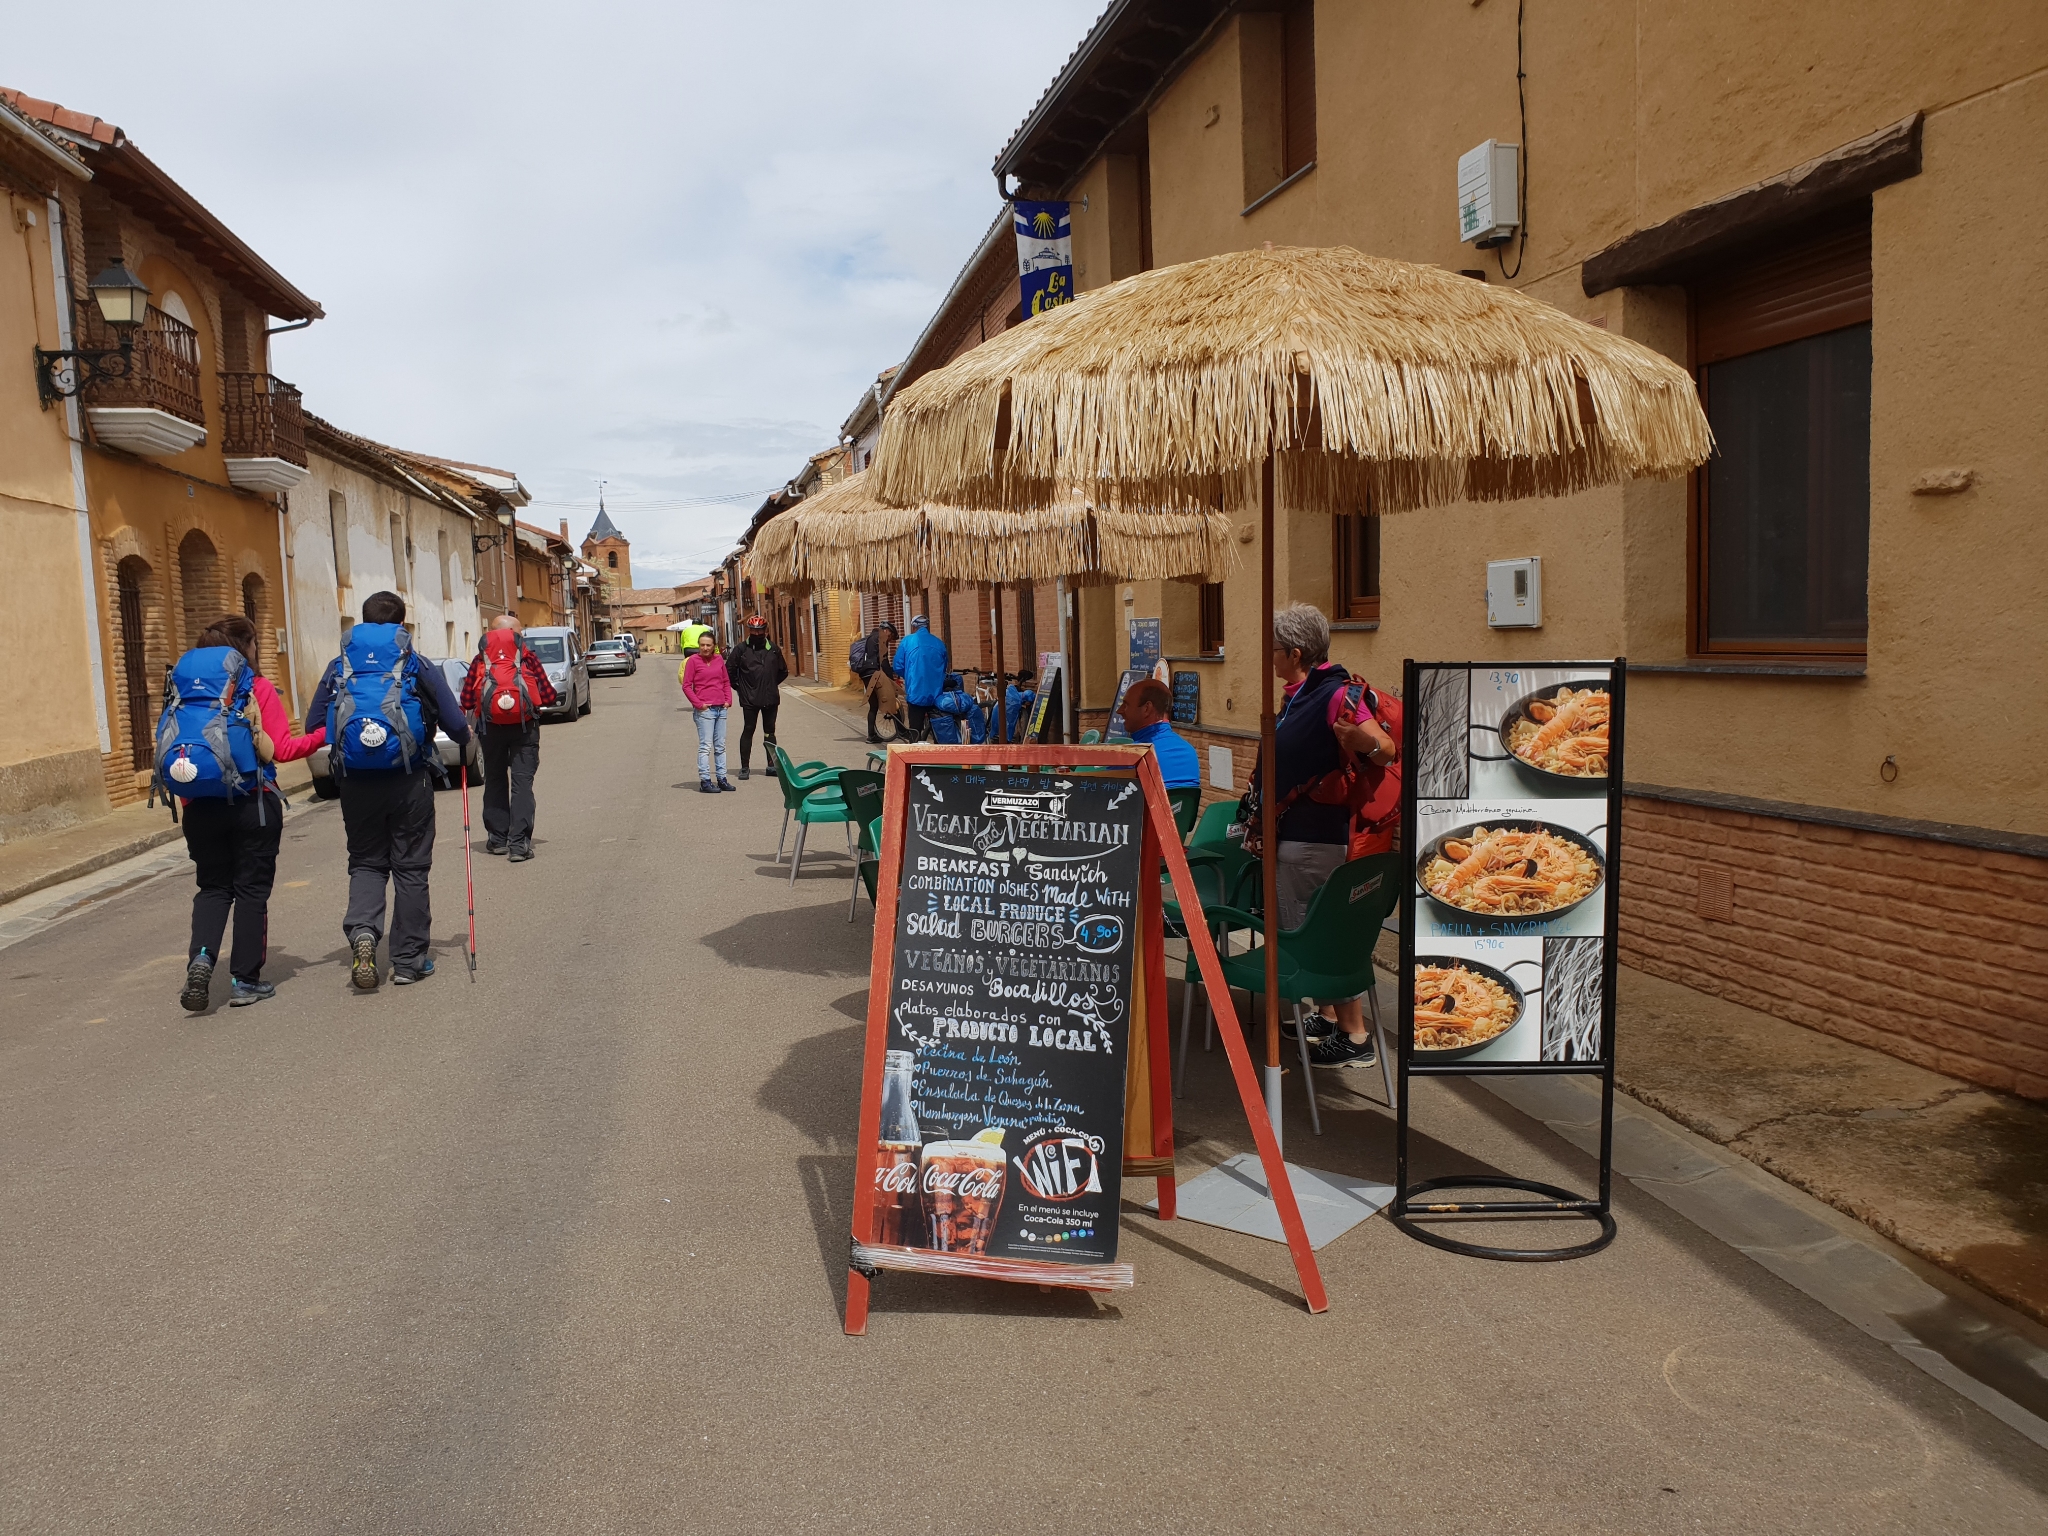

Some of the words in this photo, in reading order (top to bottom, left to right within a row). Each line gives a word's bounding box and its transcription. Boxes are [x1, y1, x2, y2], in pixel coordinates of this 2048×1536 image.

[1047, 271, 1066, 293] La
[992, 796, 1038, 807] VERMUZAZO
[976, 819, 1003, 852] and
[917, 855, 1011, 878] BREAKFAST
[1024, 860, 1108, 882] Sandwich
[1041, 880, 1094, 908] Made
[943, 894, 996, 916] LOCAL
[999, 902, 1067, 924] PRODUCE
[906, 911, 962, 939] Salad
[970, 917, 1066, 950] BURGERS
[904, 949, 985, 975] VEGANOS
[995, 955, 1121, 983] VEGETARIANOS
[901, 978, 974, 996] DESAYUNOS
[988, 976, 1097, 1011] Bocadillos
[944, 999, 1028, 1024] elaborados
[1038, 1013, 1062, 1026] con
[932, 1016, 1019, 1044] PRODUCTO
[1028, 1024, 1098, 1051] LOCAL
[922, 1043, 967, 1061] Cecina
[971, 1045, 987, 1064] de
[917, 1078, 980, 1103] Ensalada
[983, 1086, 997, 1104] de
[921, 1060, 973, 1083] Puerros
[976, 1065, 992, 1082] de
[993, 1067, 1054, 1095] Sahagún
[922, 1163, 1005, 1200] Coca-Cola
[1018, 1203, 1029, 1212] En
[1030, 1205, 1038, 1213] el
[1038, 1206, 1060, 1214] menú
[1062, 1208, 1071, 1216] se
[1072, 1207, 1099, 1218] incluye
[1023, 1214, 1064, 1225] Coca-Cola
[1065, 1217, 1081, 1226] 350
[1082, 1220, 1093, 1228] ml
